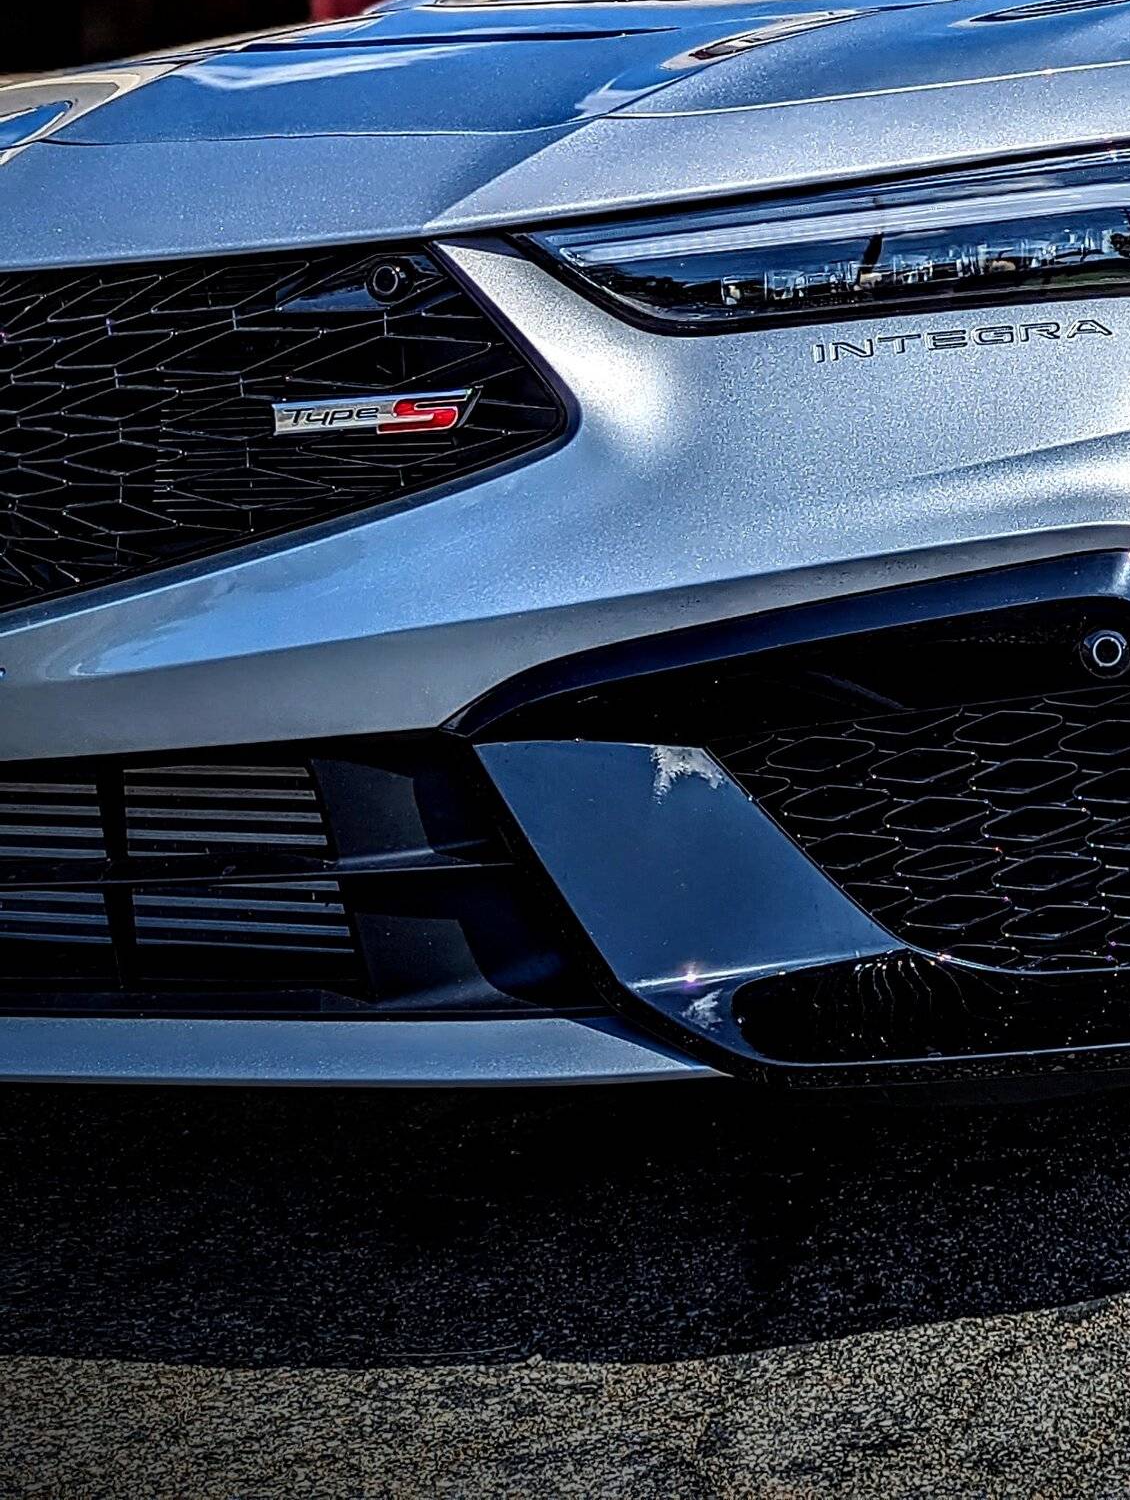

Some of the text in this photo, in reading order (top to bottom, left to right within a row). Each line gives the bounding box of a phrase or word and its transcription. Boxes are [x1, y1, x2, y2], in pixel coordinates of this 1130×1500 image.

[813, 318, 1114, 364] INTEGRA
[282, 395, 467, 435] Type S
